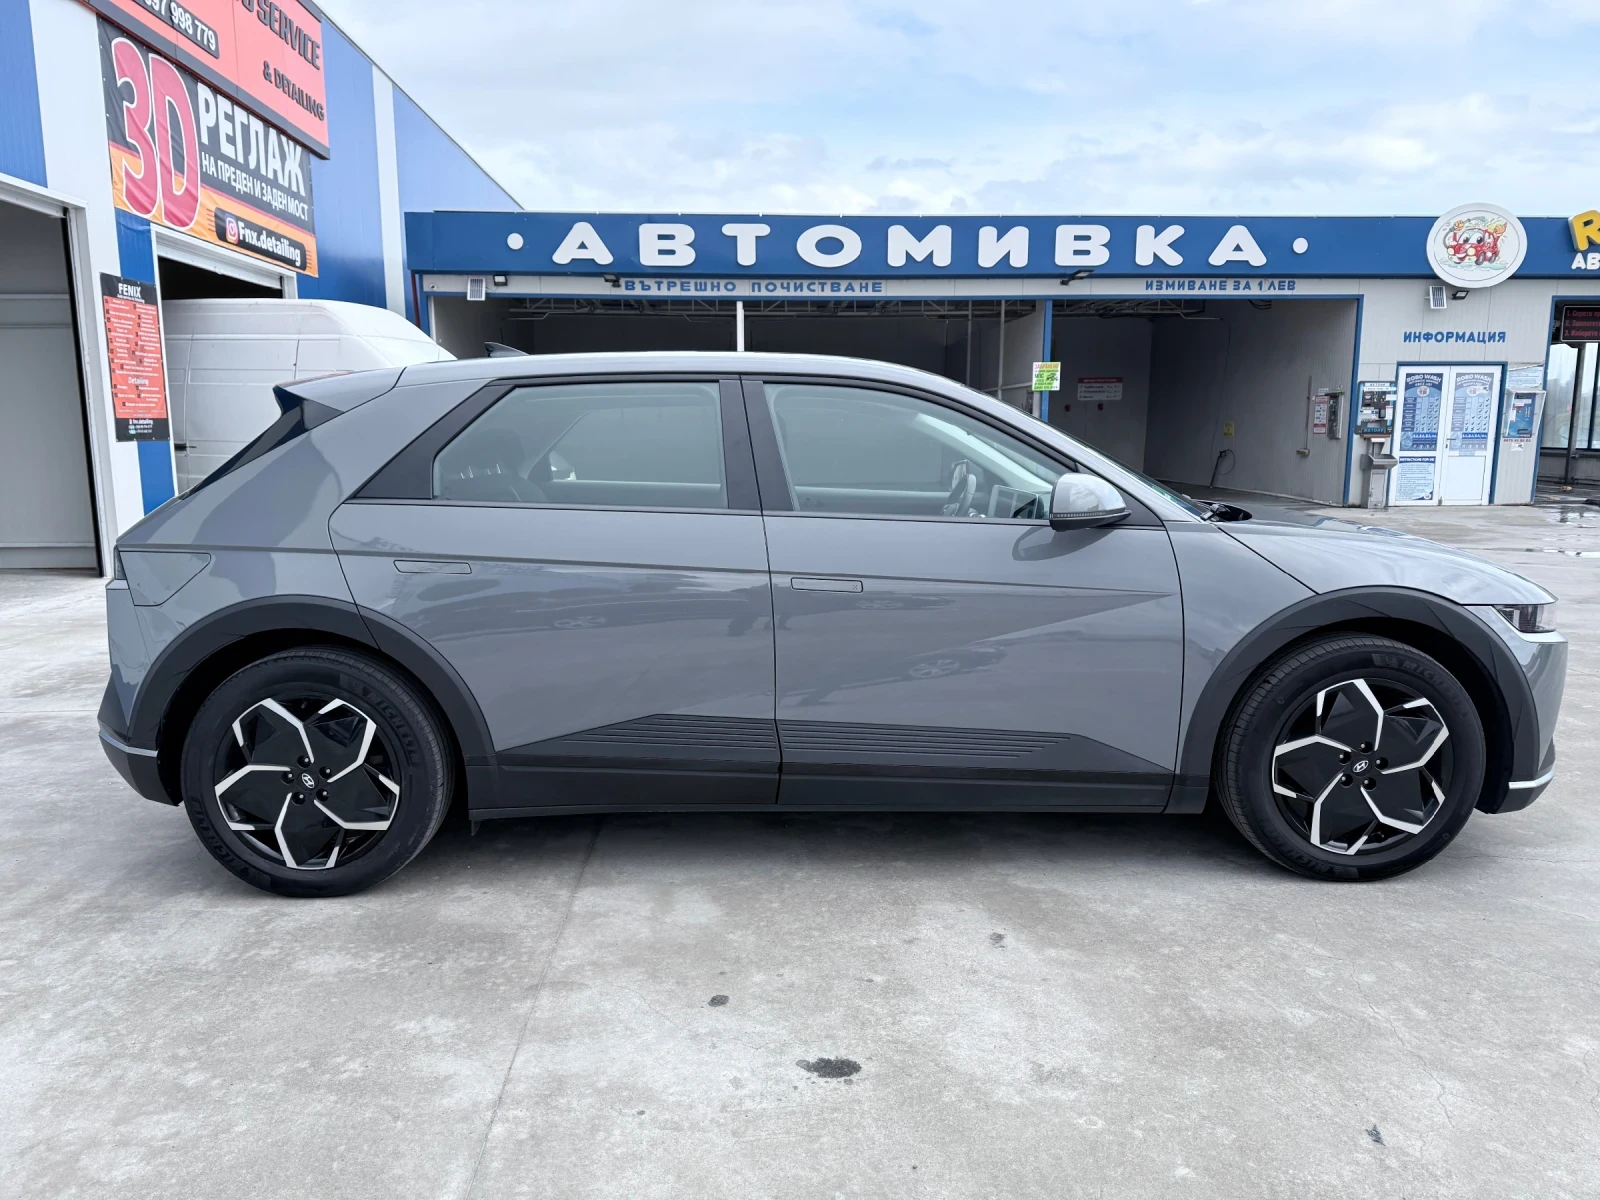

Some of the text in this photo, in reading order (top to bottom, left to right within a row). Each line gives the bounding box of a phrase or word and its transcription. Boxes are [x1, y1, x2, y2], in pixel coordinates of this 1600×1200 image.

[170, 2, 193, 35] 998
[194, 19, 216, 51] 779
[257, 0, 320, 71] SERVICE
[263, 60, 325, 122] & DETAILING
[111, 36, 200, 231] 3D
[197, 82, 306, 197] РЕГЛАЖ
[201, 151, 309, 221] НА ПРЕДЕН И ЗАДЕН МОСТ
[237, 220, 301, 267] Fnx.detailing
[551, 221, 1268, 268] АВТОМИВКА
[117, 282, 141, 298] FENIX
[624, 280, 883, 293] ВЪТРЕШНО ПОЧИСТВАНЕ
[1145, 279, 1296, 291] ИЗМИВАНЕ ЗА 1 ЛЕВ
[1403, 331, 1507, 345] ИНФОРМАЦИЯ
[1406, 374, 1424, 382] ROBO
[1424, 374, 1442, 383] WASH
[1474, 374, 1492, 383] WASH
